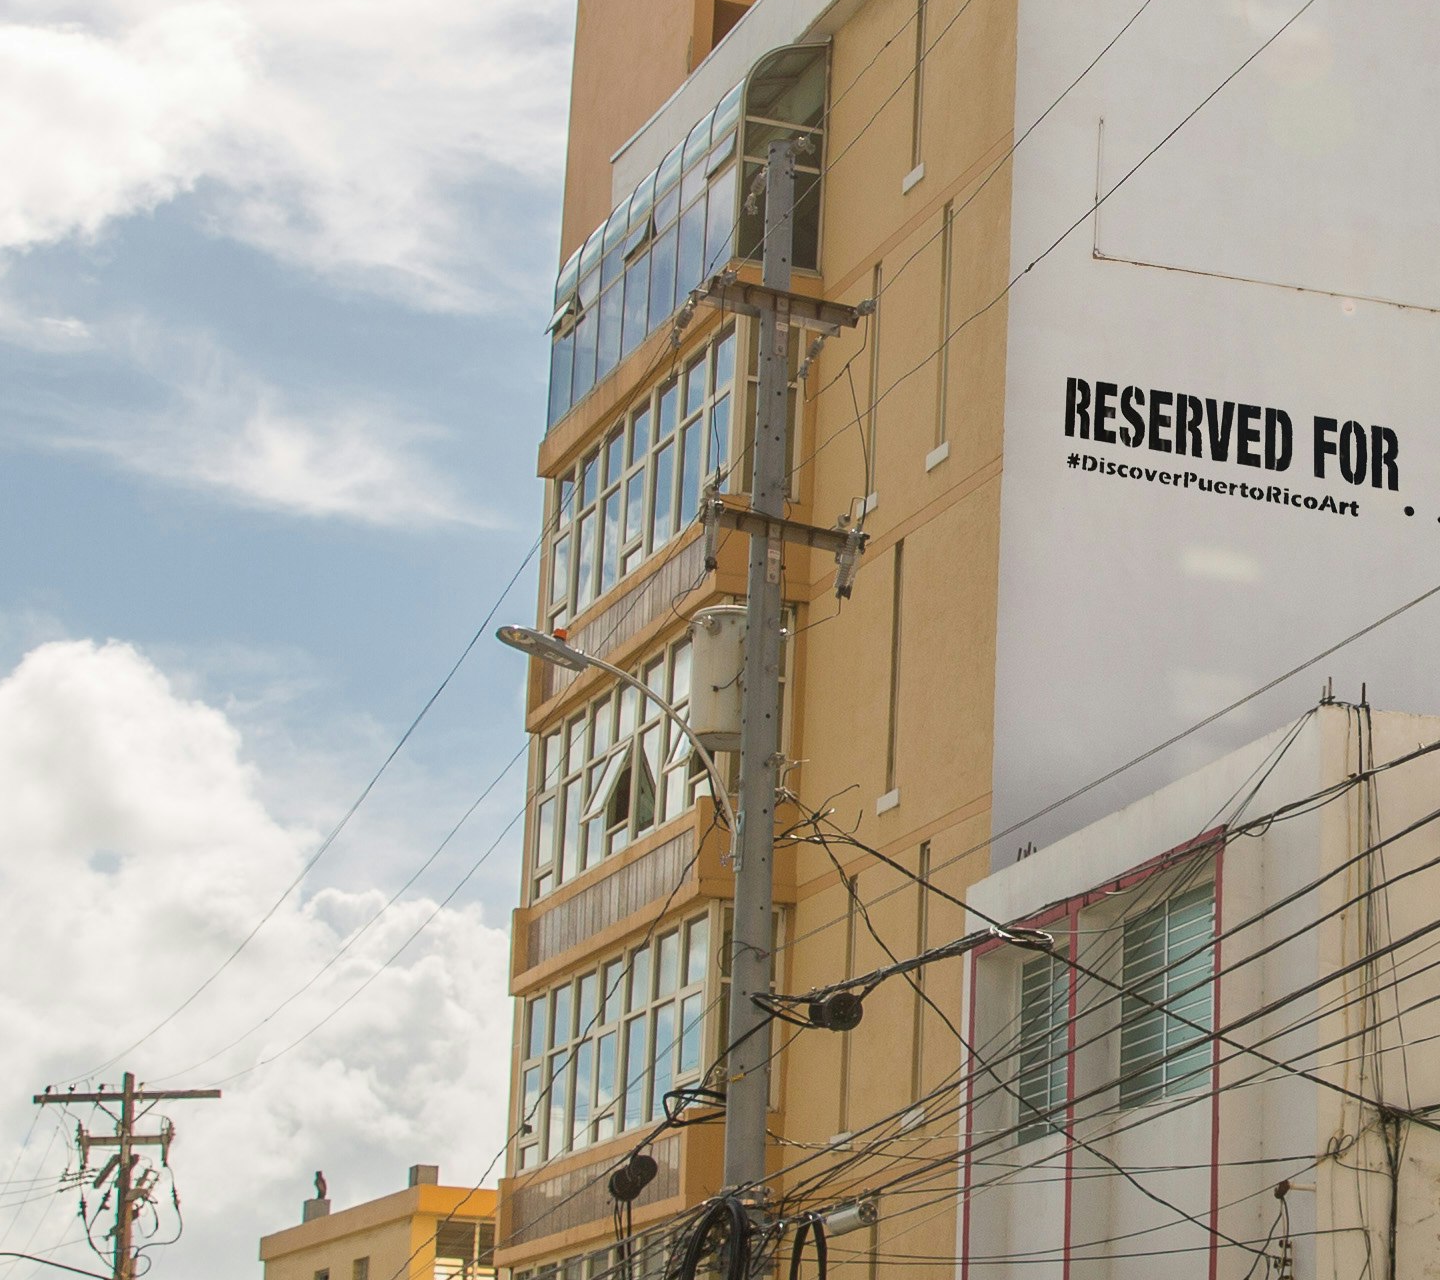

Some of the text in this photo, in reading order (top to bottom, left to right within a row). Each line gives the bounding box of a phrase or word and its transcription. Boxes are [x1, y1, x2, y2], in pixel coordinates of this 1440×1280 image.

[1064, 376, 1399, 492] RESERVED FOR
[1067, 452, 1360, 517] #DiscoverPuertoRicoArt
